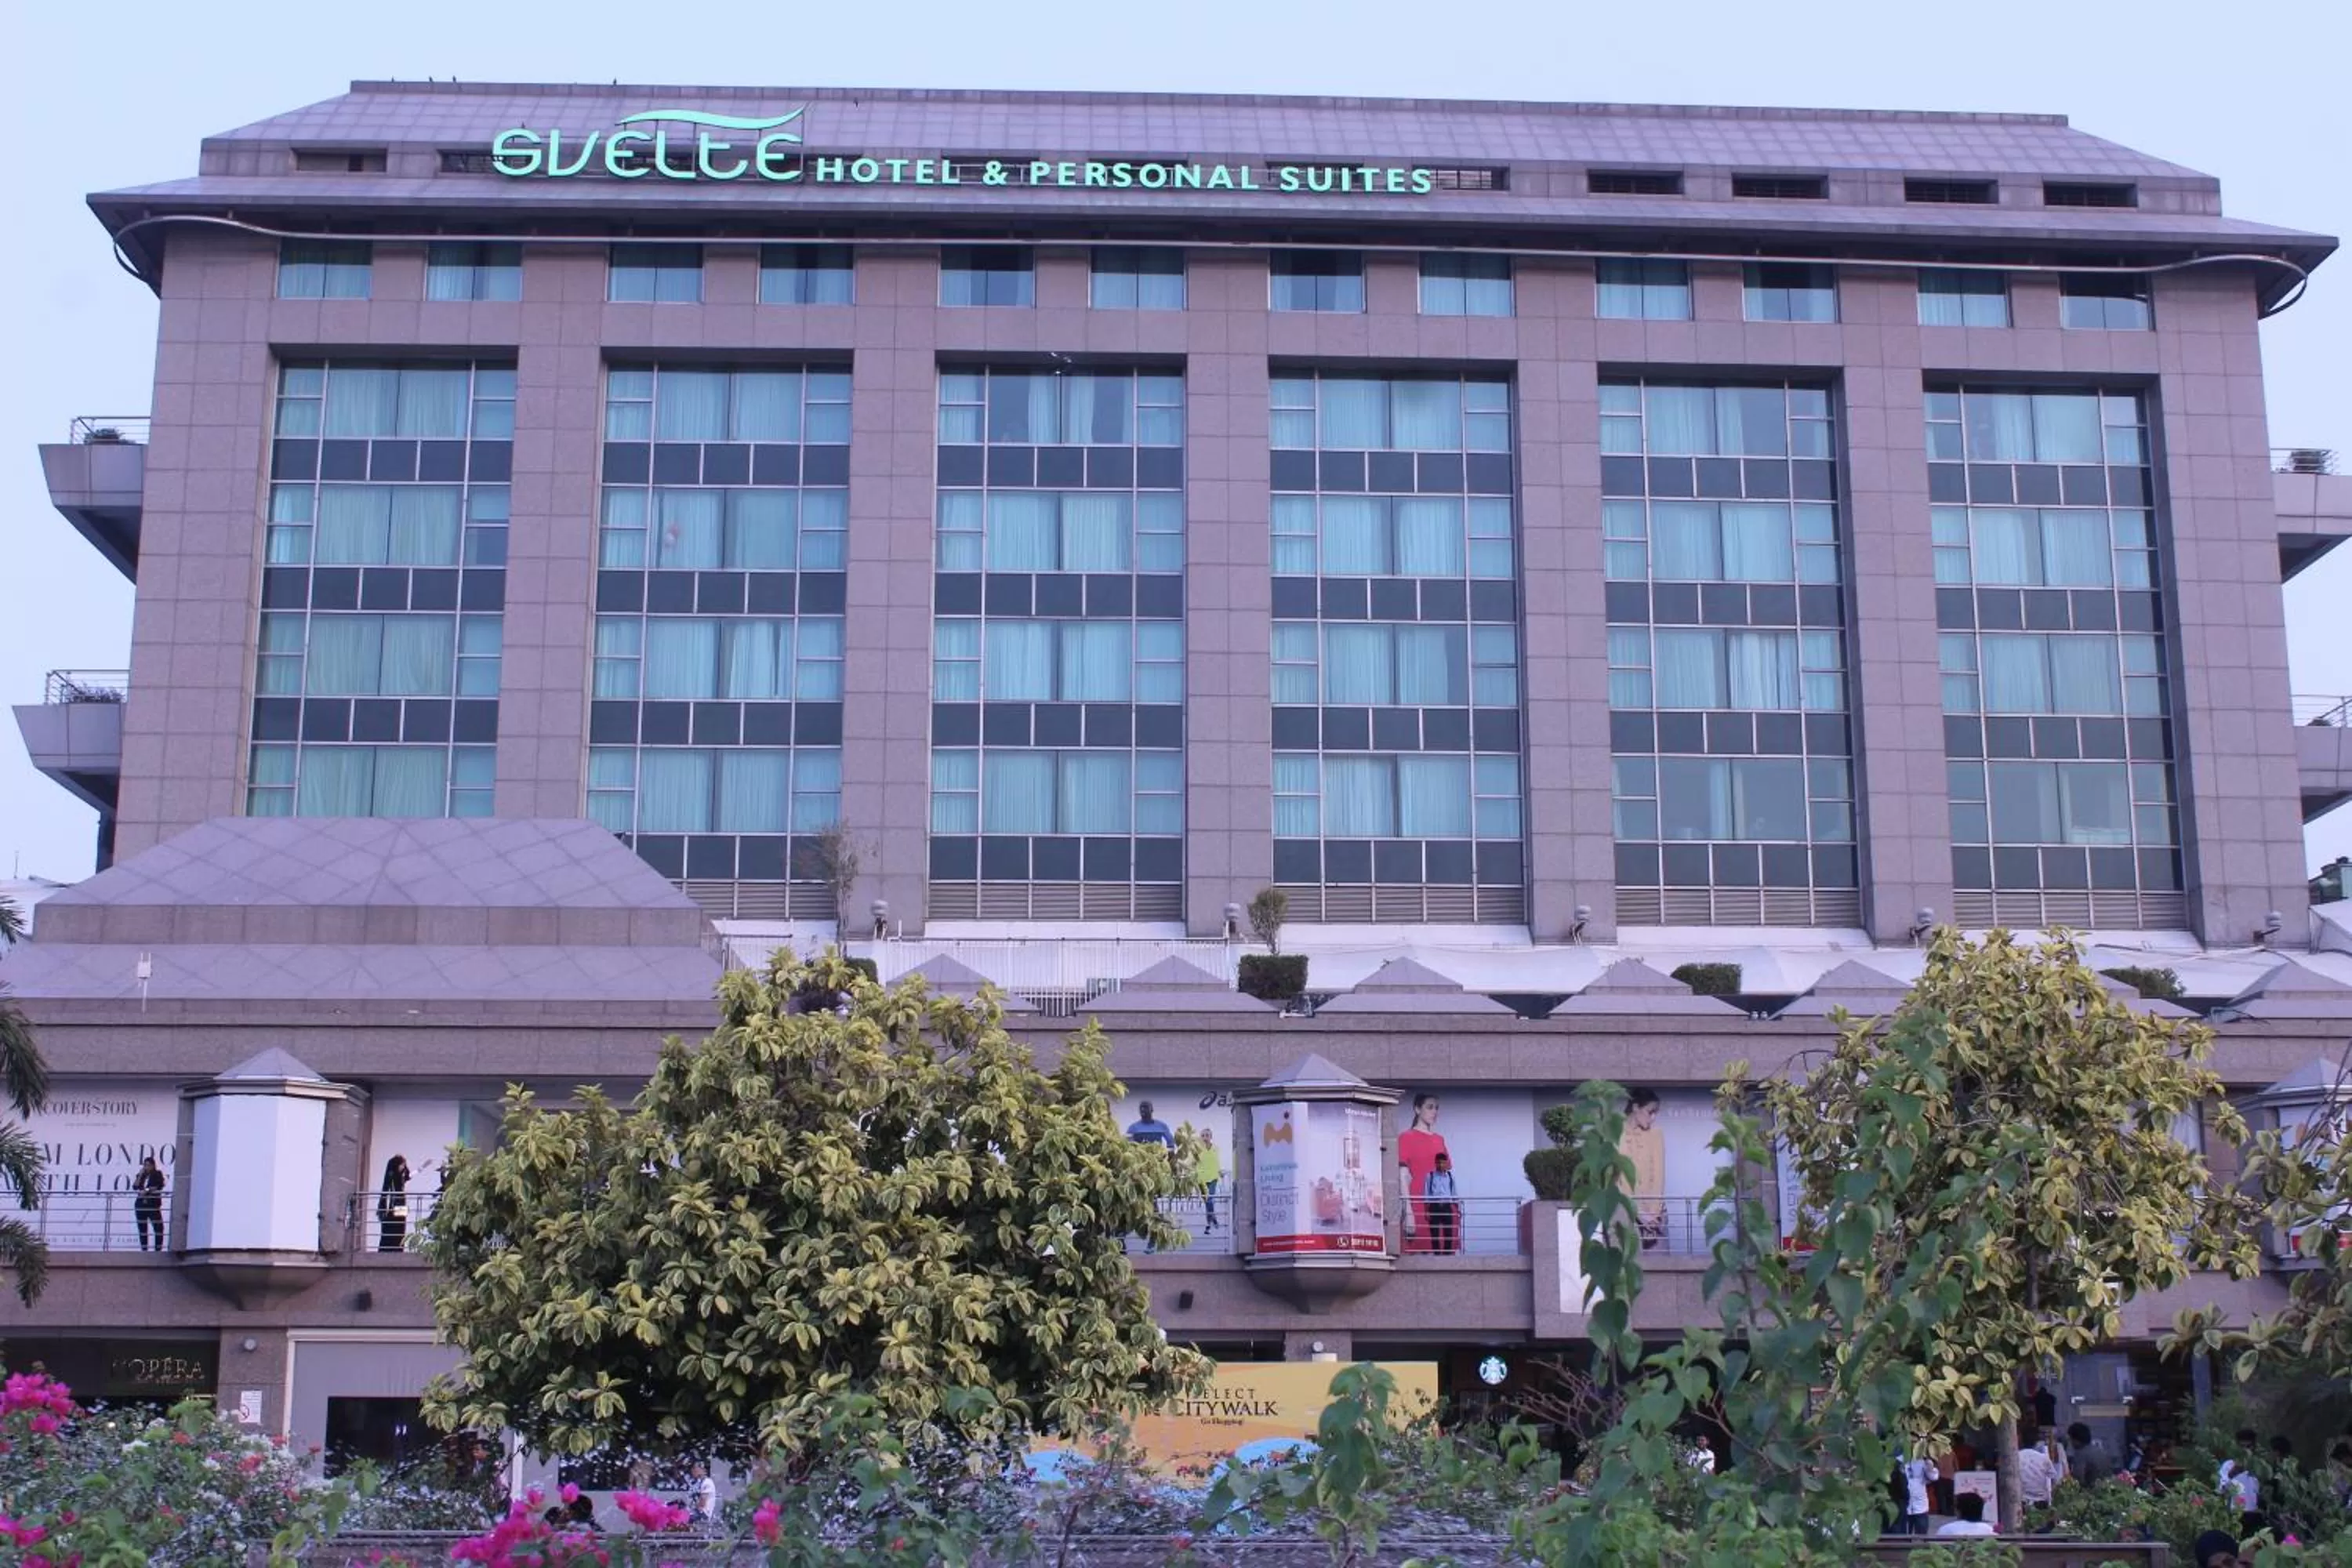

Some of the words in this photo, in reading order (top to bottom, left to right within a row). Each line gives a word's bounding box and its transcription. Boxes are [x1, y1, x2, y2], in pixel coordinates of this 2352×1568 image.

[815, 157, 959, 186] HOTEL
[982, 161, 1009, 187] &
[1029, 162, 1260, 193] PERSONAL
[1279, 167, 1432, 196] SUITES
[1192, 1388, 1256, 1399] ELECT
